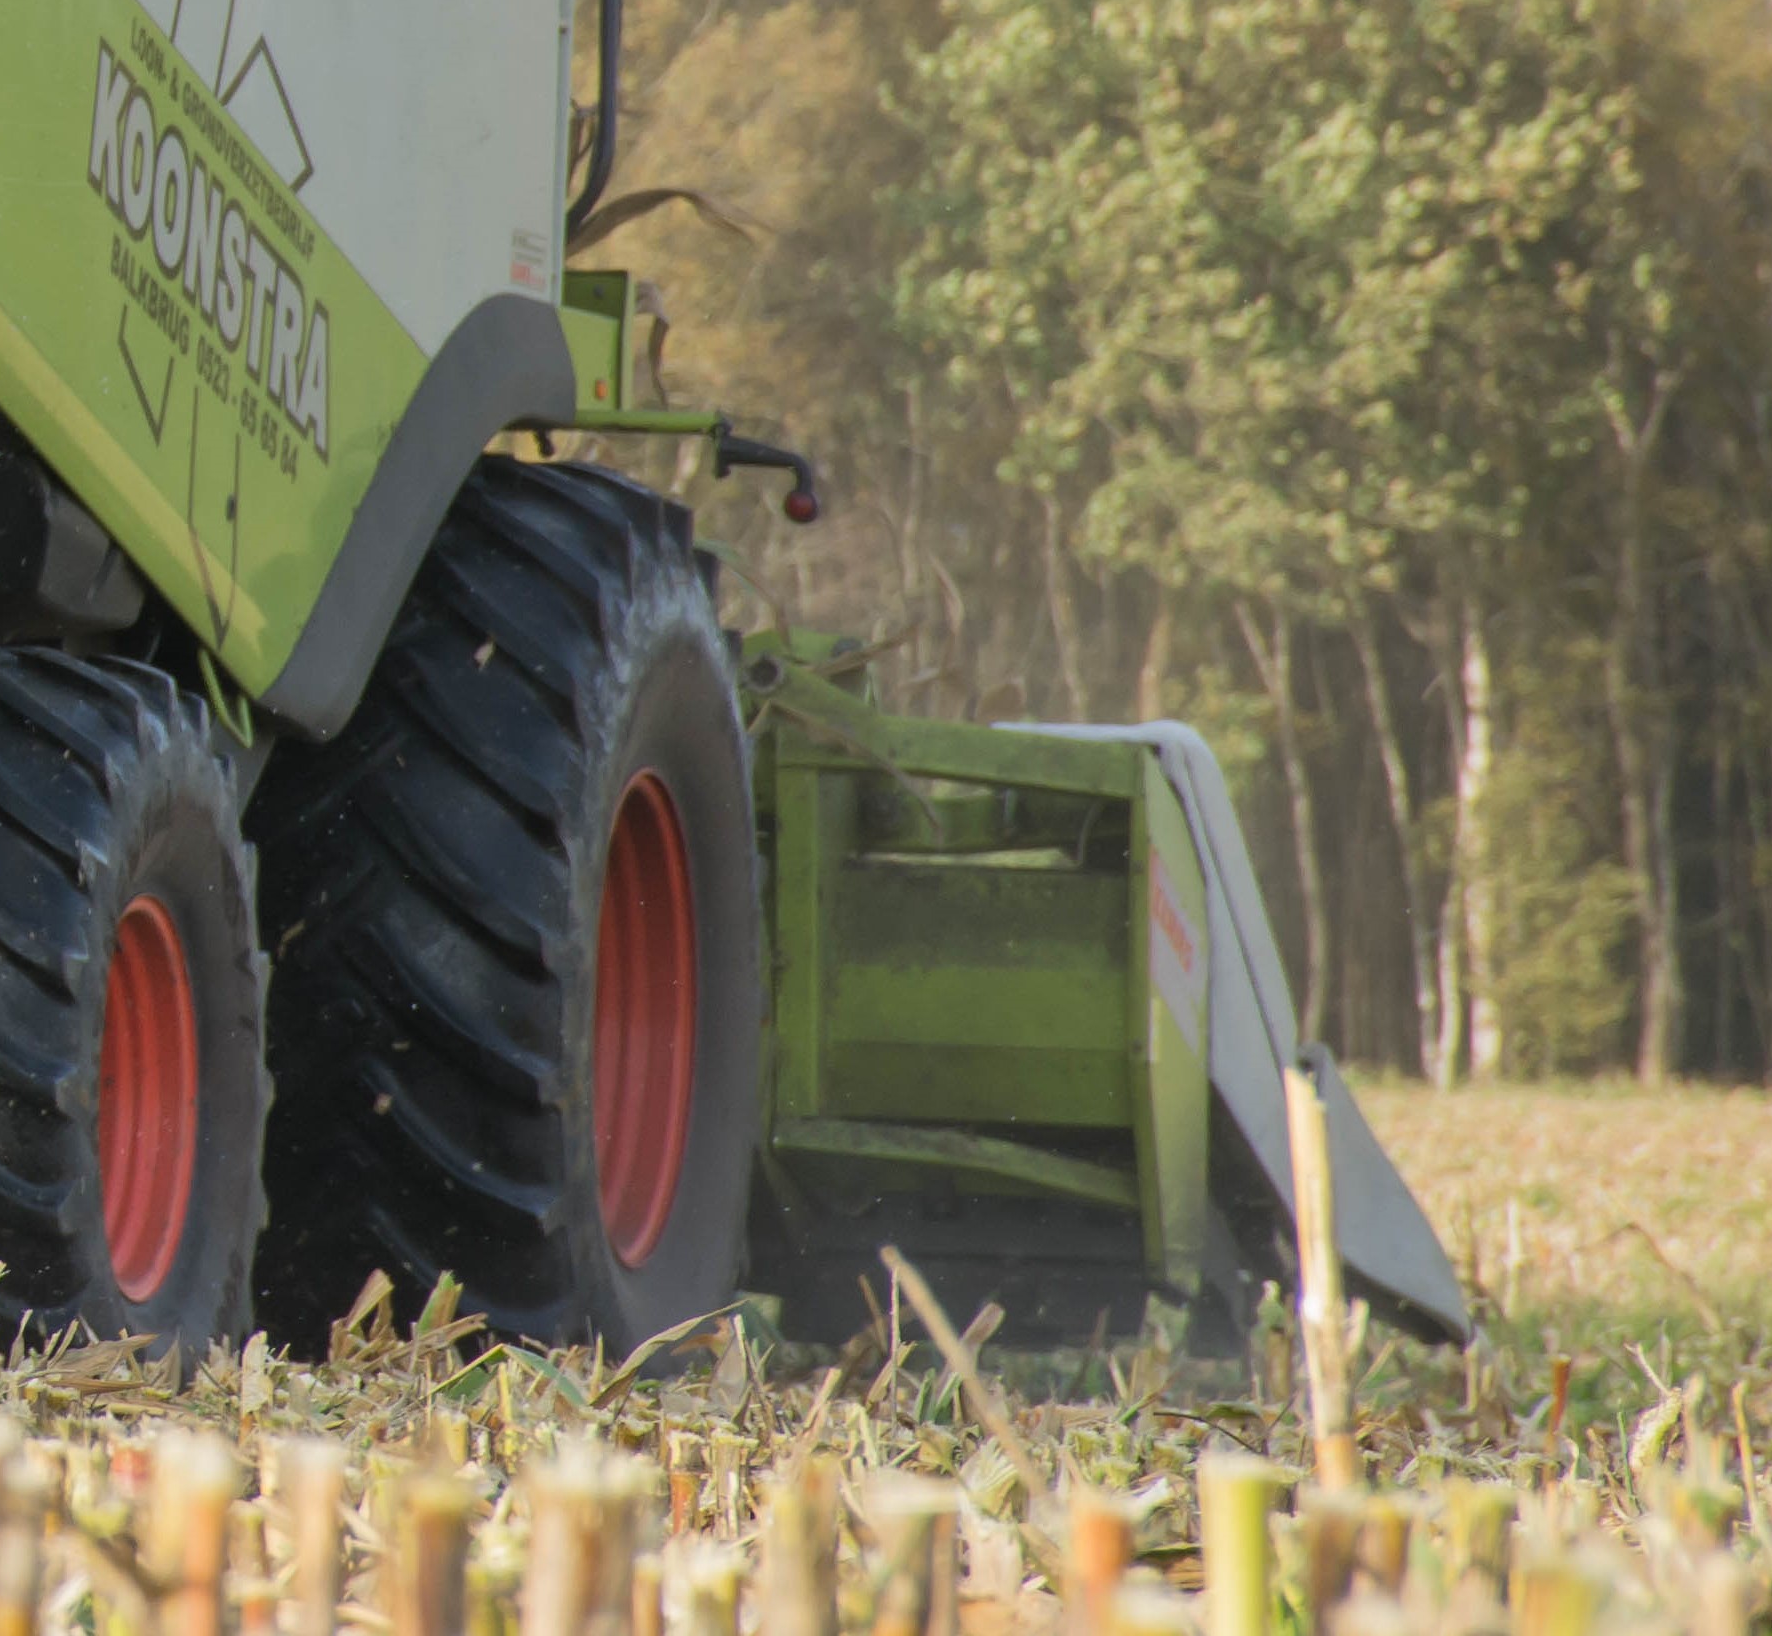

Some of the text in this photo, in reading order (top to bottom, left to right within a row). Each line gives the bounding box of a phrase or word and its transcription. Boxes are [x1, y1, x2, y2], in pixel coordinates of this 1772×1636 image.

[88, 35, 330, 467] KOONSTRA
[111, 232, 190, 356] BALKBRUG
[196, 335, 230, 404] 0523
[280, 433, 298, 485] 84
